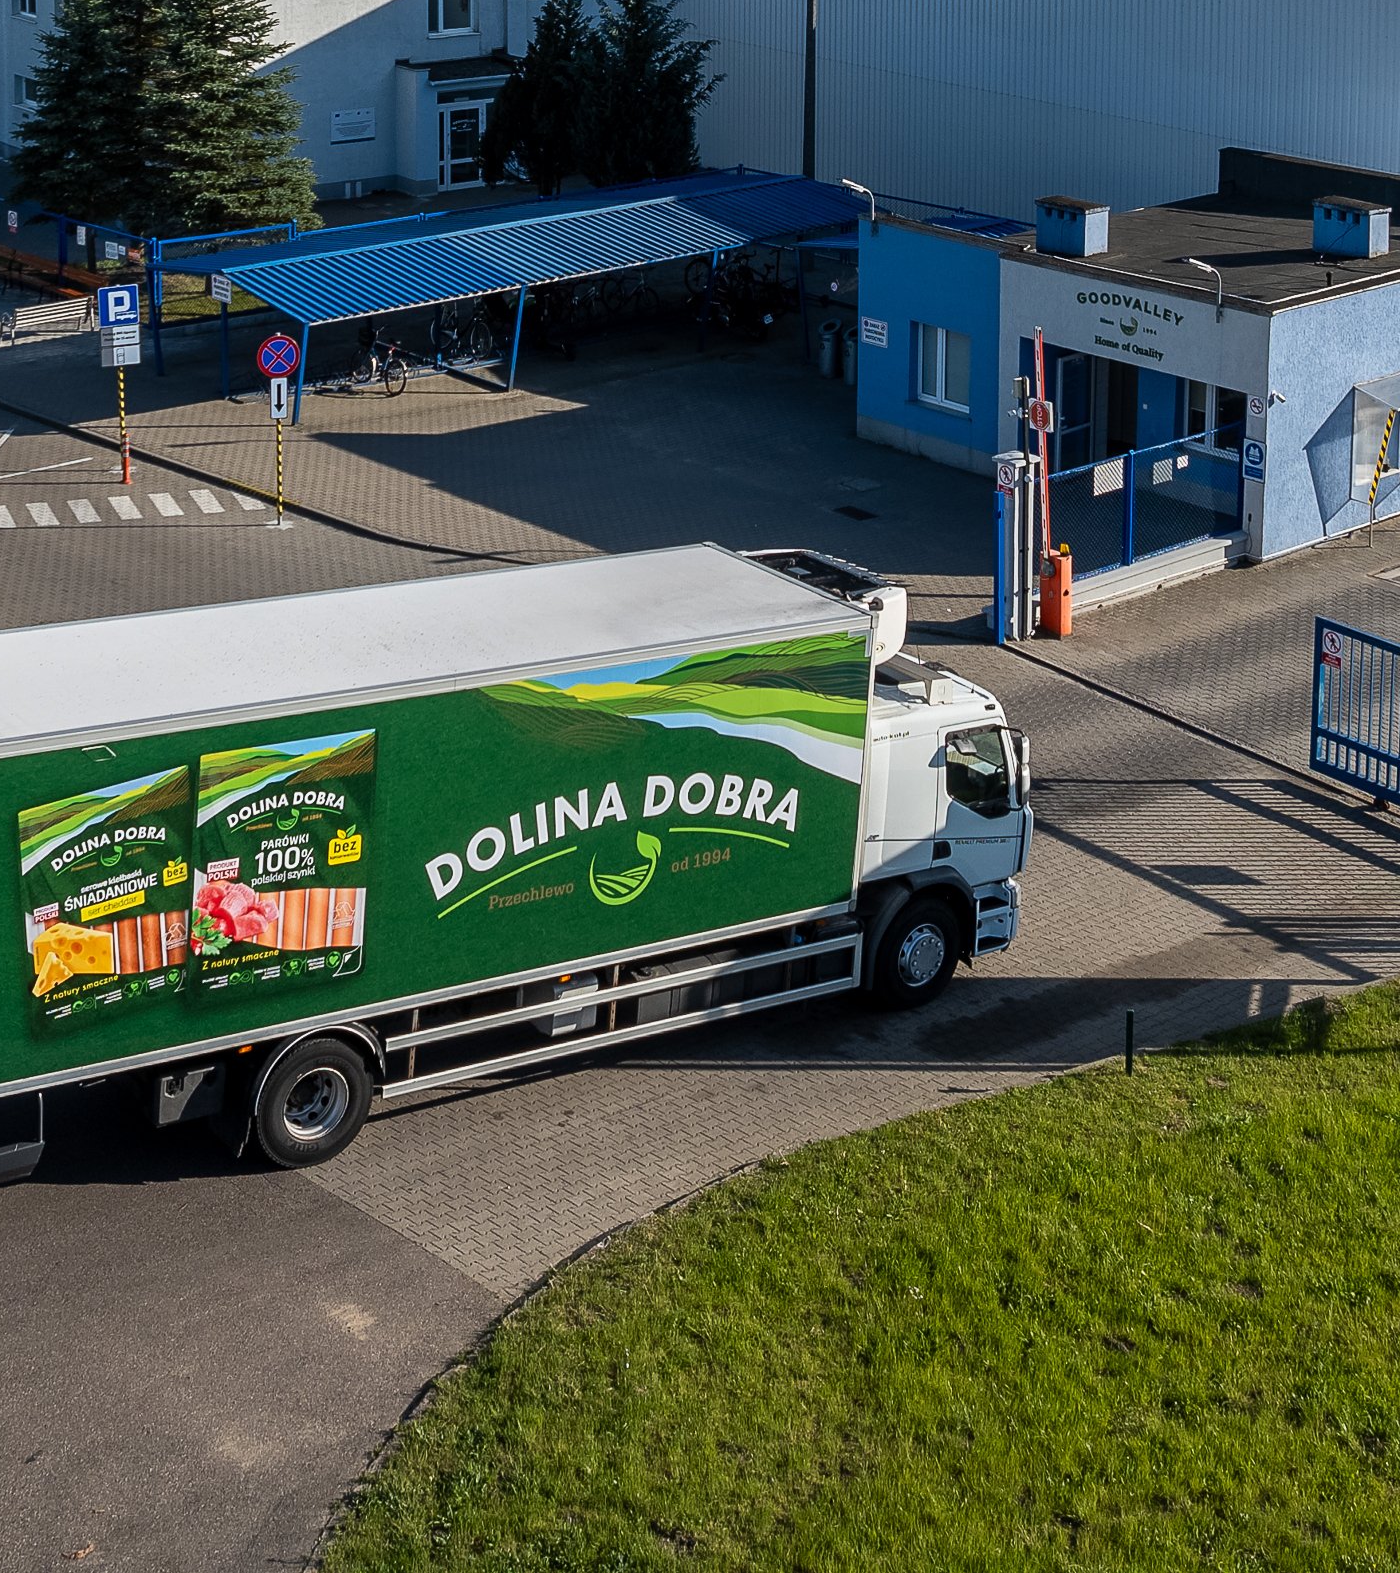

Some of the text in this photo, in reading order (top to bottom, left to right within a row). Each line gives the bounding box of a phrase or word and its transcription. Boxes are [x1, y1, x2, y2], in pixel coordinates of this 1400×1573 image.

[107, 290, 131, 322] P
[1076, 292, 1184, 326] GOODVALLEY
[1094, 335, 1164, 362] Home of Quality
[226, 791, 345, 828] DOLINA DOBRA
[51, 826, 166, 872] DOLINA DOBRA
[261, 833, 310, 851] PARÓWKI
[333, 840, 357, 854] bez
[425, 772, 799, 901] DOLINA DOBRA
[166, 867, 184, 878] bez
[208, 860, 238, 870] PRODUKT
[254, 846, 315, 875] 100%
[207, 868, 238, 881] POLSKI
[251, 866, 316, 888] polskiej szynki
[488, 847, 731, 911] Przechlewo od 1994
[64, 872, 158, 912] ŚNIADANIOWE
[34, 910, 59, 924] POLSKI
[87, 896, 138, 917] ser cheddar
[201, 949, 280, 970] Z natury smaczne
[44, 994, 51, 1003] Z
[52, 985, 80, 1000] natury
[82, 974, 119, 991] smaczne
